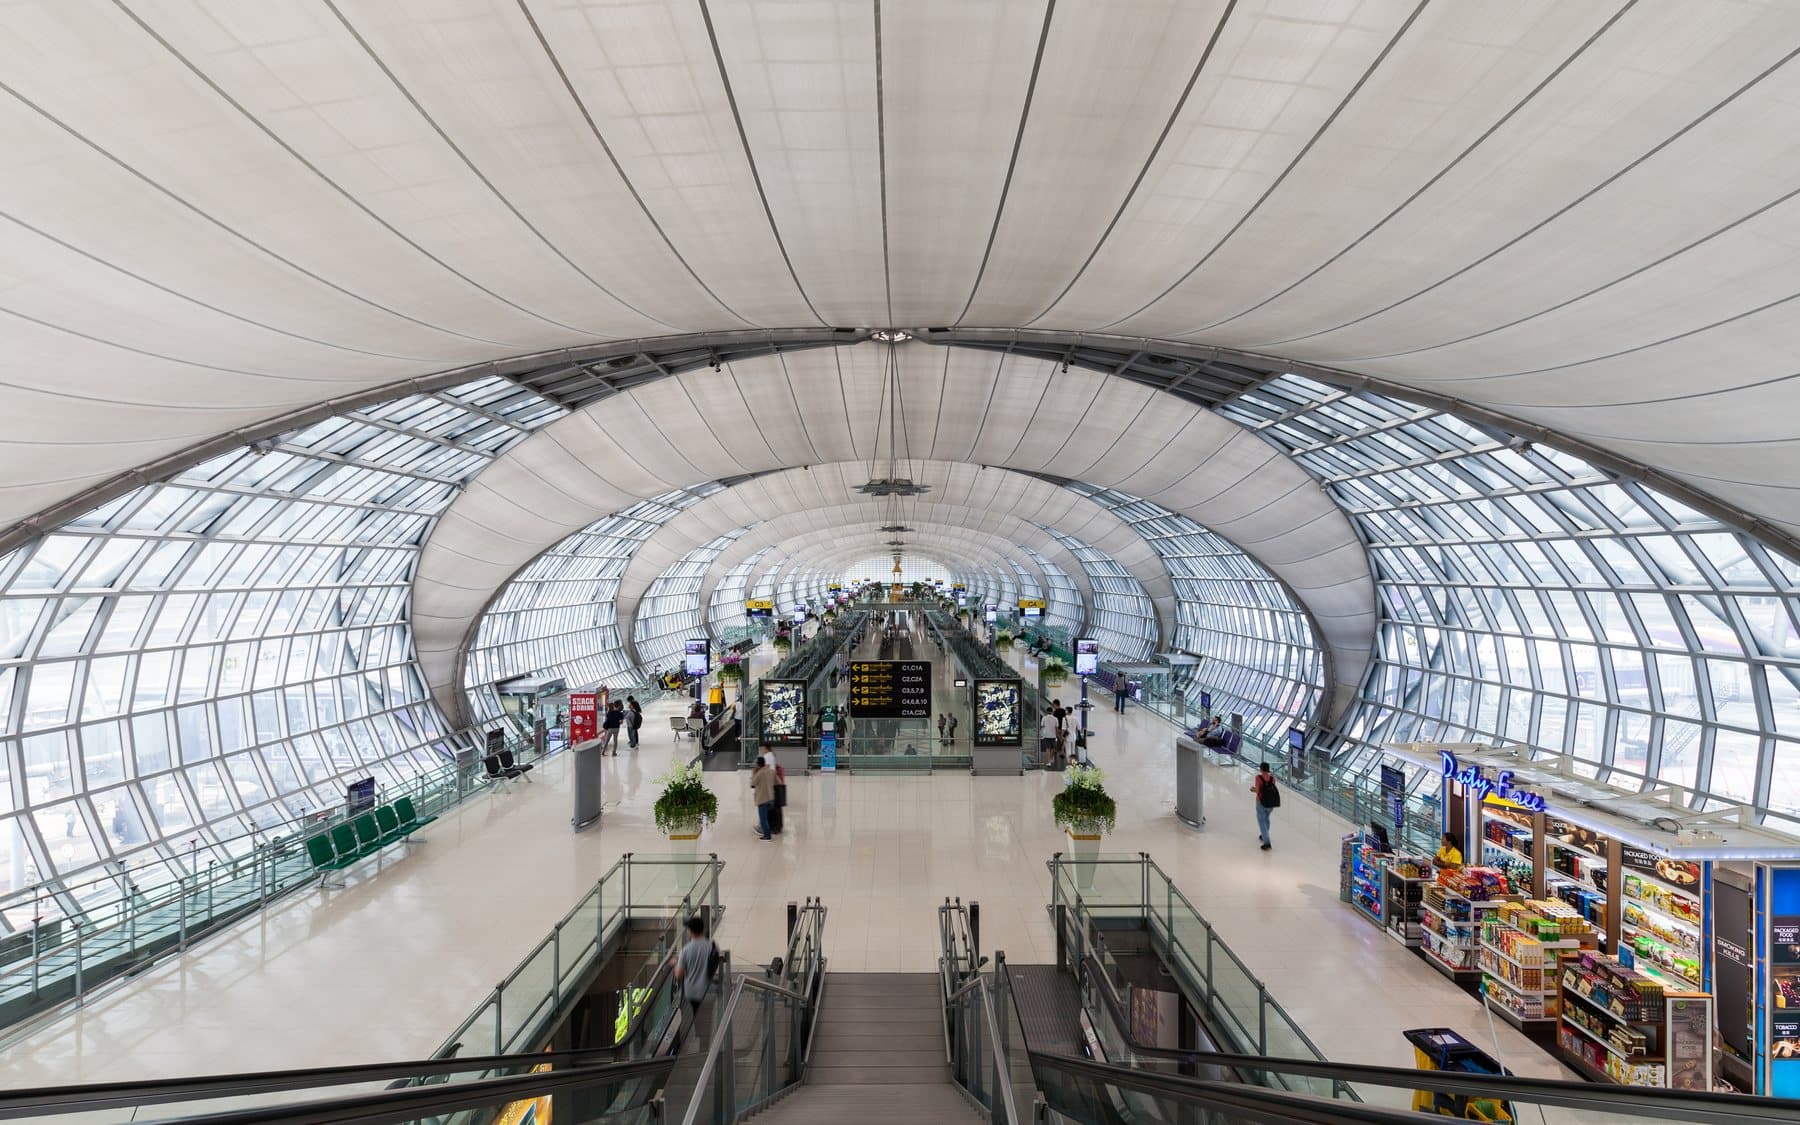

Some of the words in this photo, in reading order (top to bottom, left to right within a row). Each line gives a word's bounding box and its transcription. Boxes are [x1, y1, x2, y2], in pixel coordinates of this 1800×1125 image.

[1440, 750, 1491, 800] Duty
[1497, 770, 1546, 813] Free
[1717, 939, 1745, 957] SMOKING
[1723, 949, 1740, 961] KILLS
